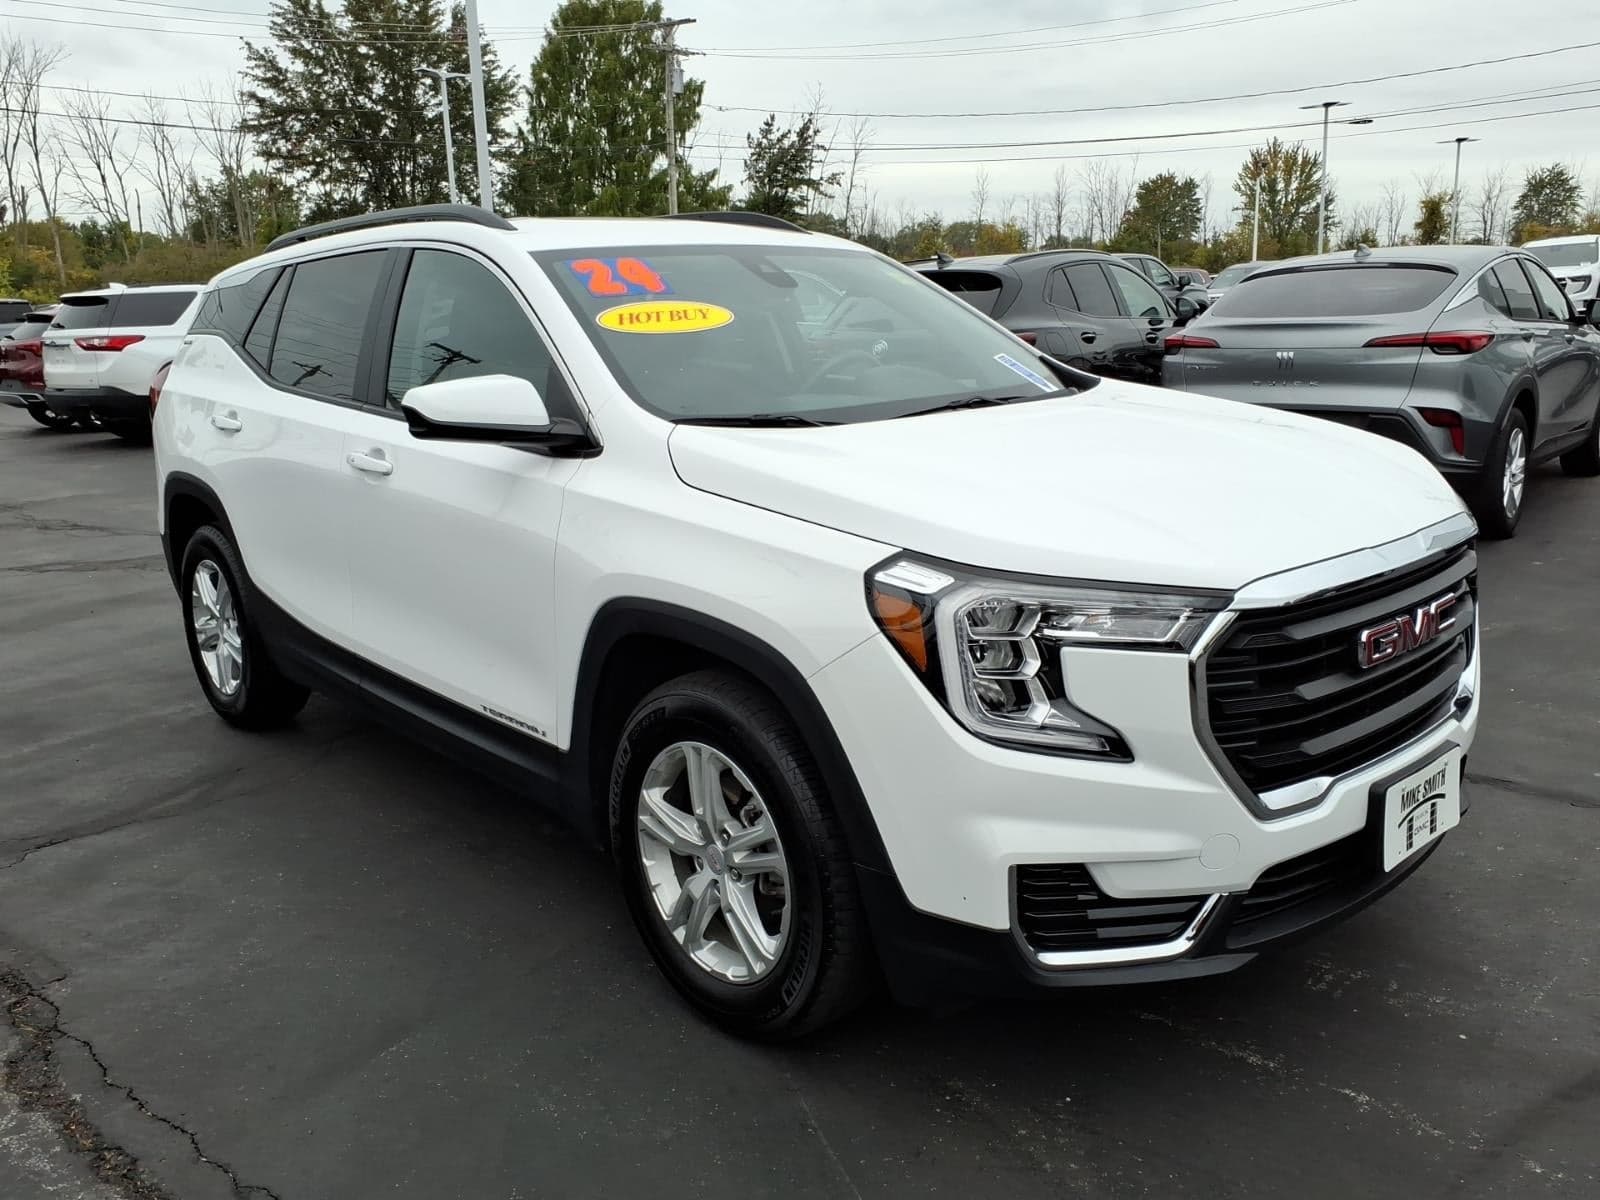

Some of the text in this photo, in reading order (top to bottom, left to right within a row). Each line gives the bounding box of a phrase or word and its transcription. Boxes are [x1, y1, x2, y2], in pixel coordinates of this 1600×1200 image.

[571, 256, 666, 296] 24
[617, 307, 711, 326] HOT BUY
[1358, 592, 1457, 669] GMC
[1400, 767, 1447, 814] MIKE SMITH
